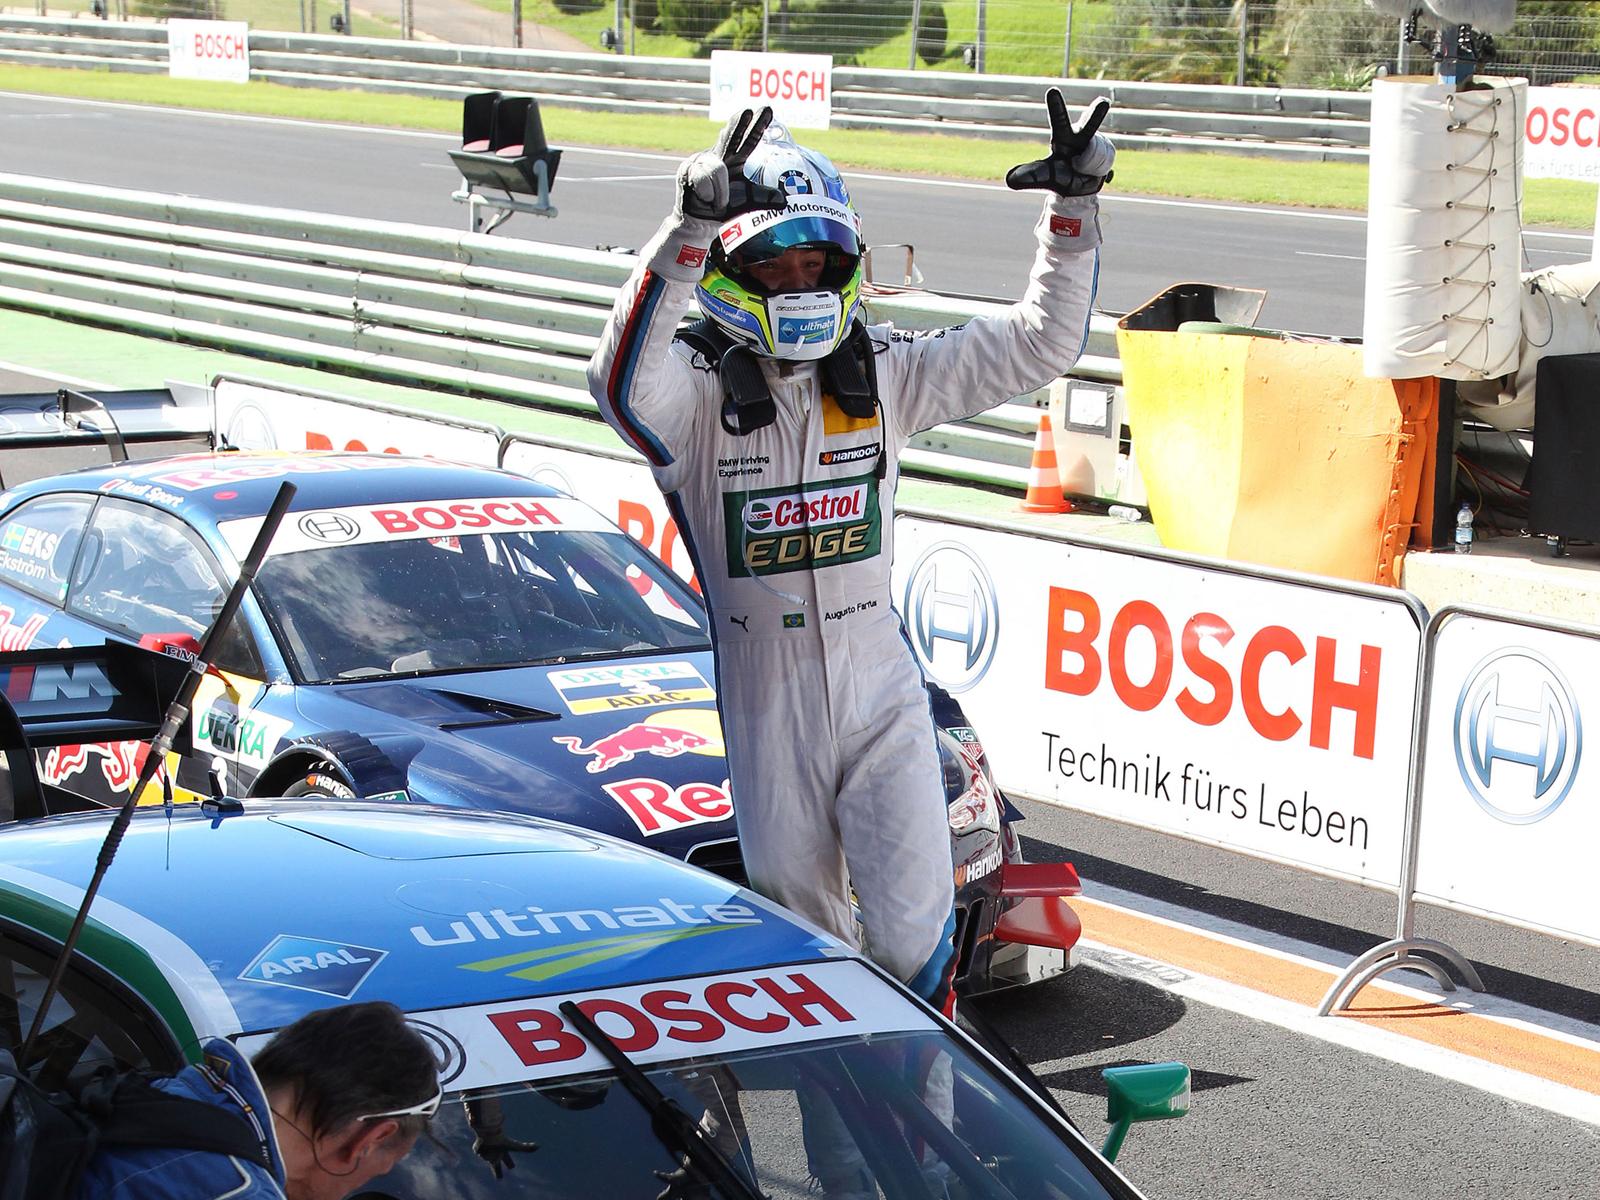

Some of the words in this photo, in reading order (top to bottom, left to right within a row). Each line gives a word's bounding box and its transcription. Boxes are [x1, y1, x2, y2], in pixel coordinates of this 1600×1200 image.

[195, 33, 244, 59] BOSCH
[750, 68, 825, 101] BOSCH
[1526, 106, 1600, 148] OSC
[751, 208, 785, 227] BMW
[786, 202, 848, 221] Motorsport
[371, 503, 562, 533] BOSCH
[775, 489, 860, 527] Castrol
[19, 527, 57, 560] EKS
[746, 522, 873, 567] EDGE
[1045, 585, 1382, 760] BOSCH
[606, 692, 690, 709] ADAC
[602, 778, 735, 837] Re
[1042, 731, 1171, 801] Technik
[1182, 763, 1248, 819] fürs
[1260, 783, 1368, 850] Leben
[409, 897, 762, 948] ultimate
[259, 948, 371, 979] ARAL
[488, 972, 857, 1067] BOSCH
